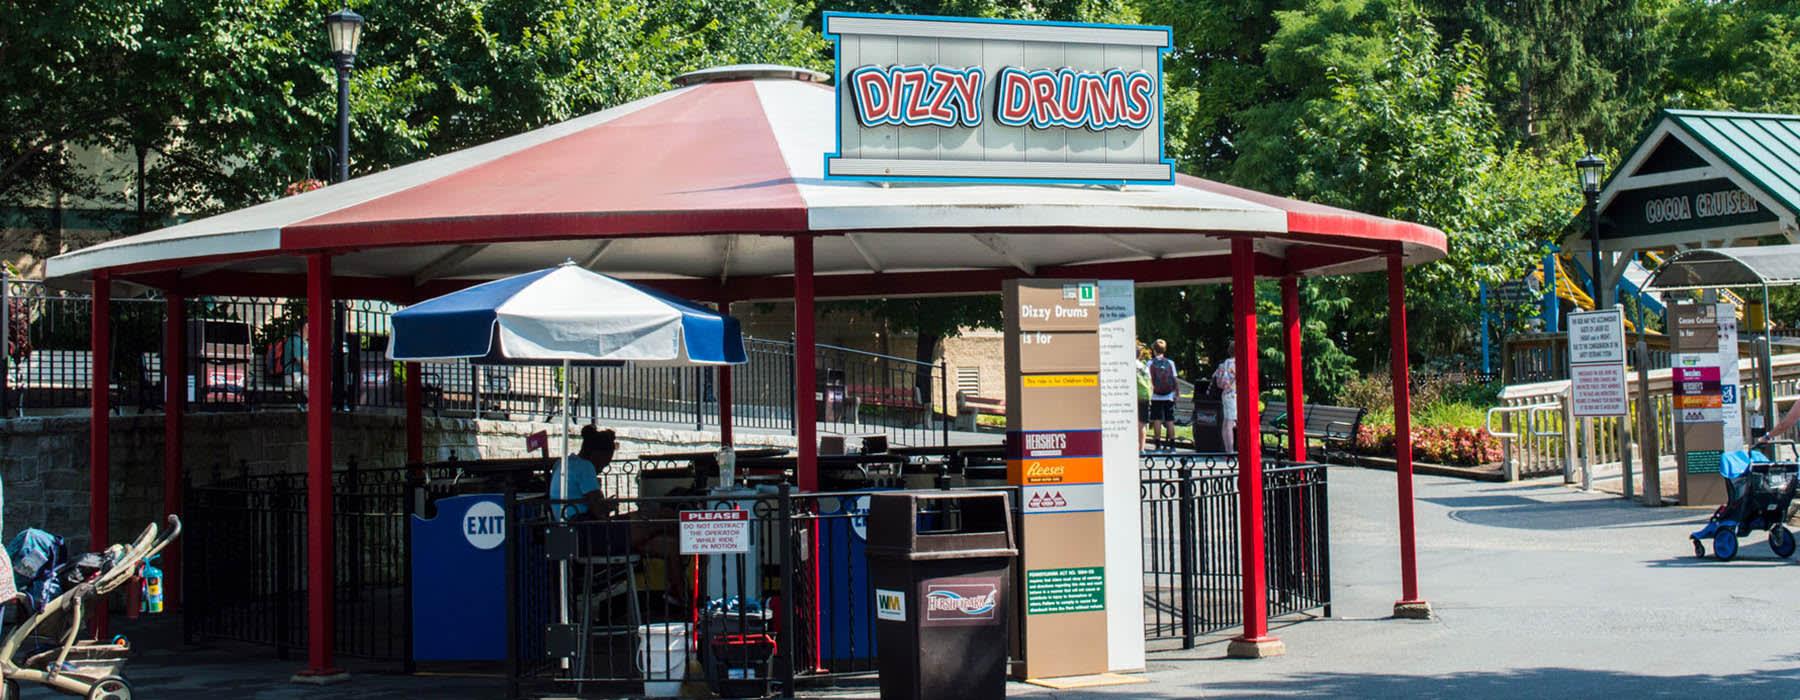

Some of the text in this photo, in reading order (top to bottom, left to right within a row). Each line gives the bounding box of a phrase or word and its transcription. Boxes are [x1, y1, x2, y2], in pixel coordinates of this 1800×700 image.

[852, 65, 1154, 131] DIZZY DRUMS
[1646, 190, 1758, 223] COCOA CRUISER
[1022, 304, 1088, 320] Dizzy Drums
[1036, 330, 1052, 344] for
[1026, 433, 1066, 450] HERSHEY'S
[468, 516, 504, 535] EXIT
[878, 594, 901, 610] WM
